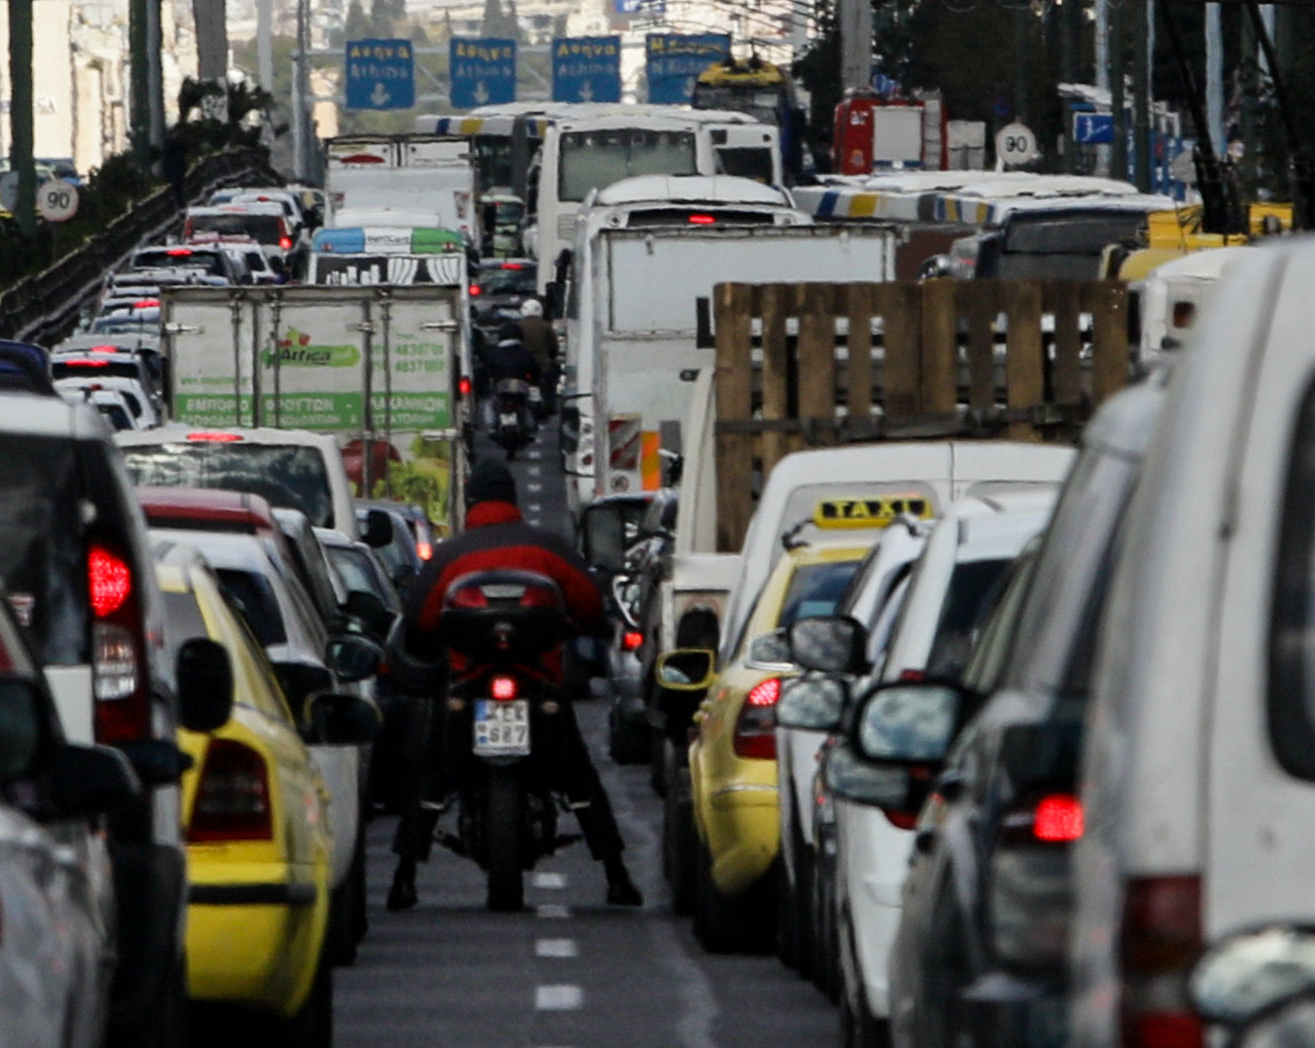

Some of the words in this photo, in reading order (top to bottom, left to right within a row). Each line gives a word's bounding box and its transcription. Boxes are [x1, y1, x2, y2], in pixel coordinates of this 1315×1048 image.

[47, 192, 70, 209] 90
[185, 398, 249, 412] ΕΜΠΟΡΟ
[832, 500, 910, 518] TAXI
